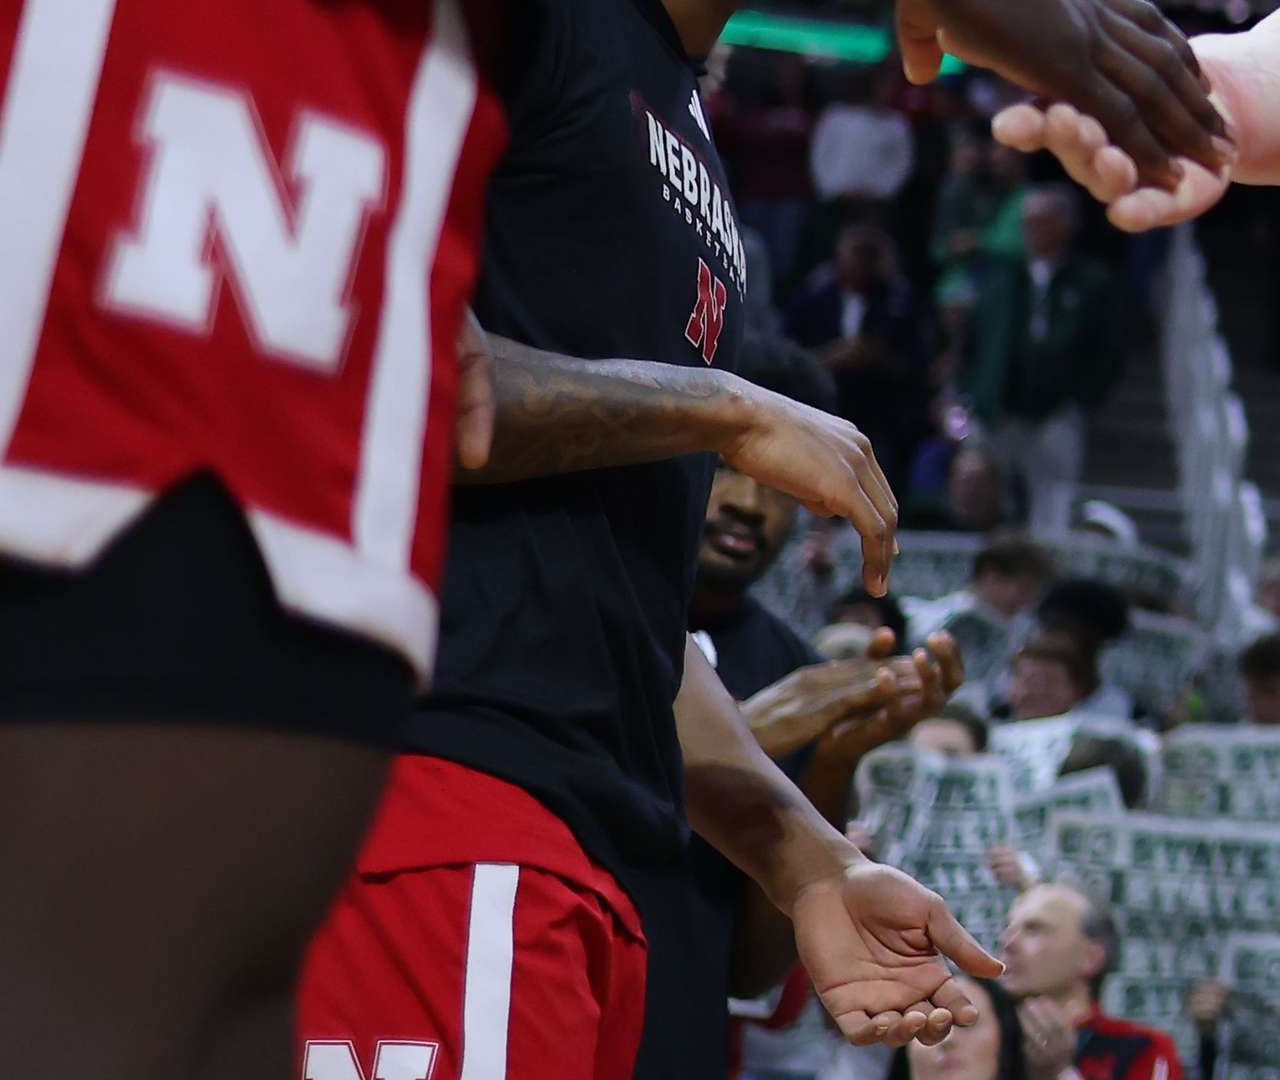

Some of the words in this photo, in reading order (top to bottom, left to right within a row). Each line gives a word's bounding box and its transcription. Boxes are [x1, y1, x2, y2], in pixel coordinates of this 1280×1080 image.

[100, 67, 388, 375] N
[646, 110, 747, 296] NEBRASKA
[685, 256, 727, 366] N
